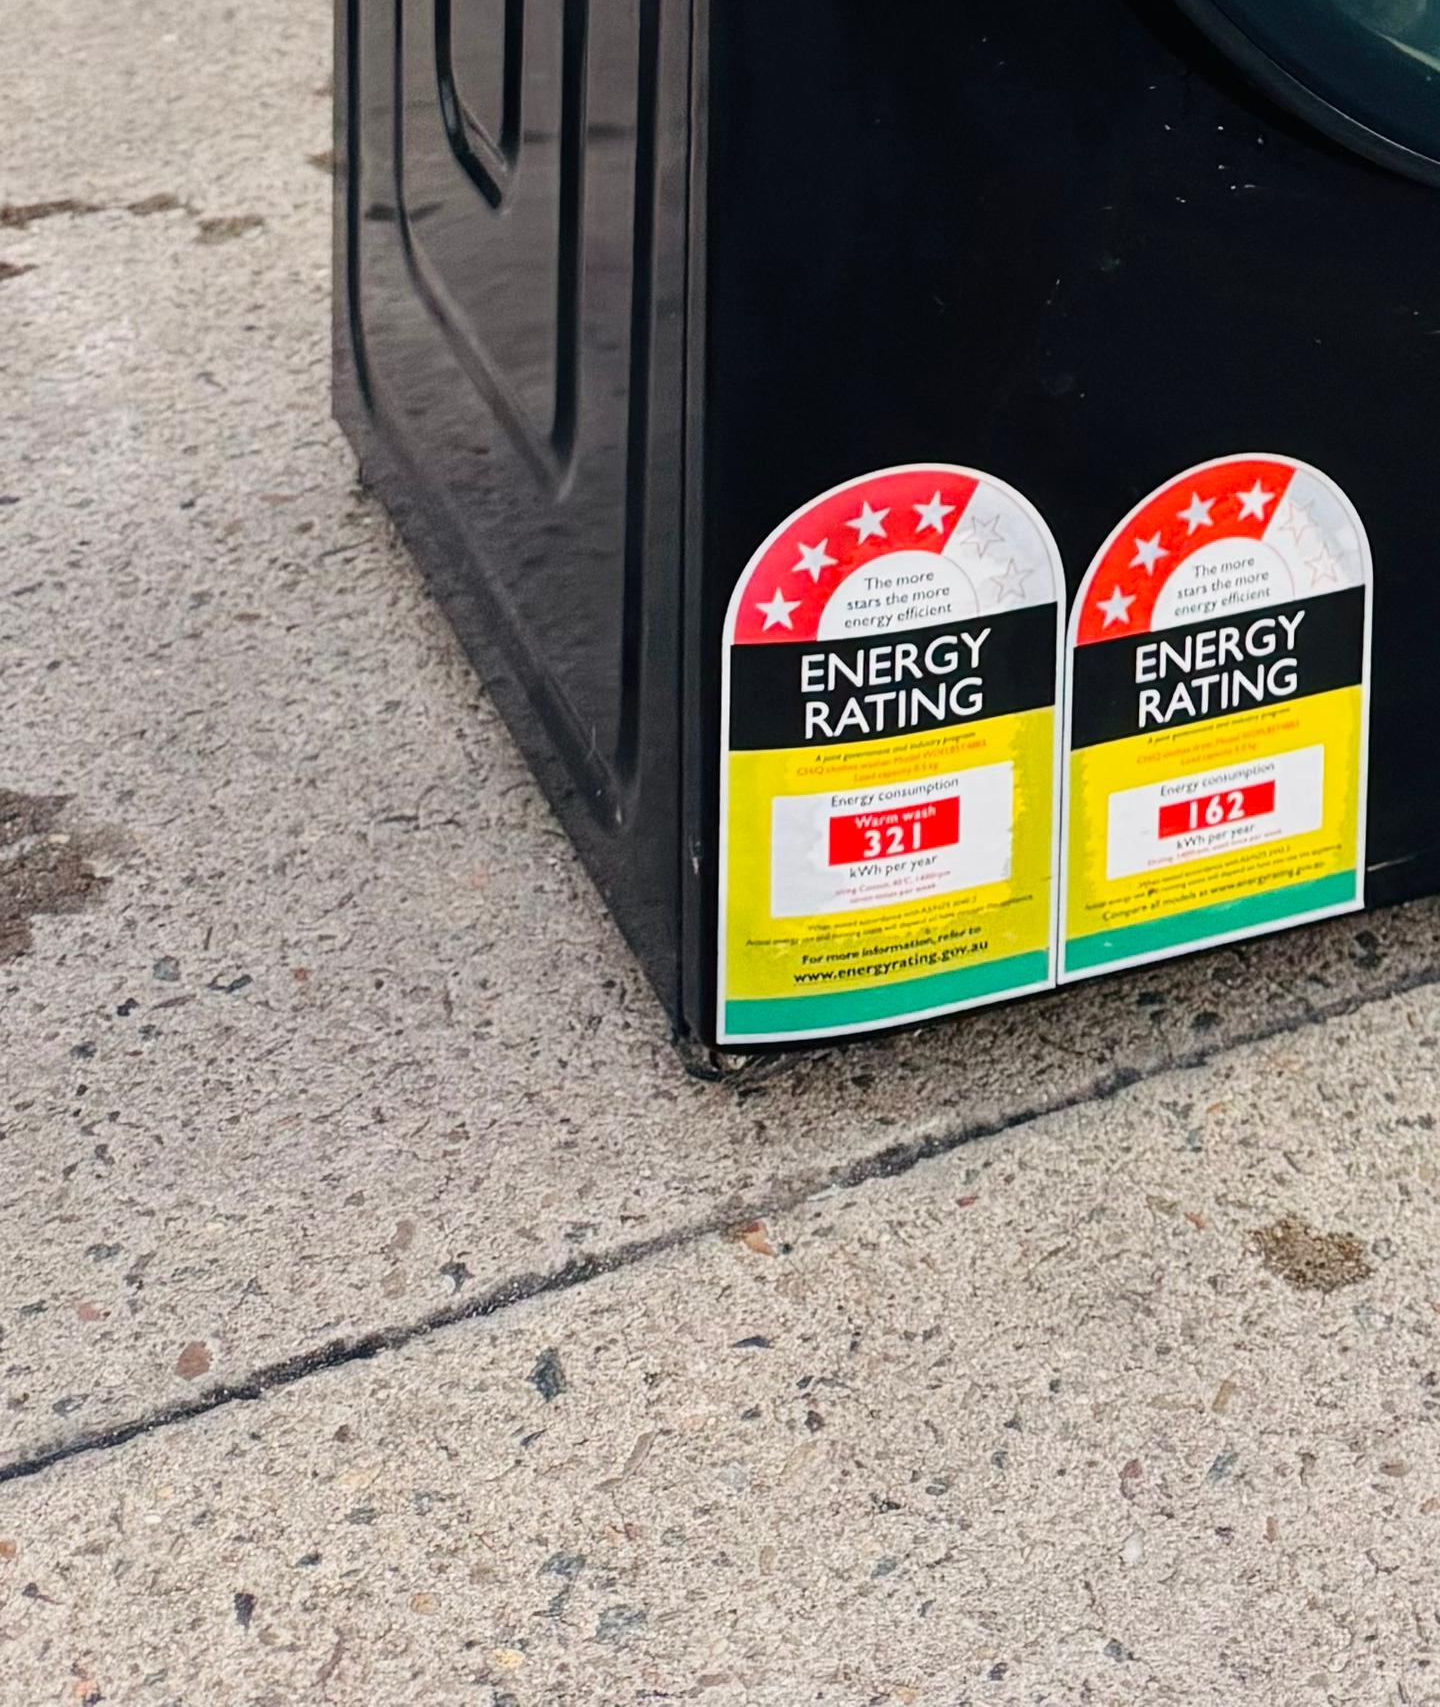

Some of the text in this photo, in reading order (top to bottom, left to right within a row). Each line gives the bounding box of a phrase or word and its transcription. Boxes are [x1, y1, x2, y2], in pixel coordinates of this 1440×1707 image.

[865, 571, 935, 592] The more
[1193, 557, 1255, 579] The more
[847, 585, 951, 611] stars the more
[1177, 570, 1269, 600] stars the more
[844, 602, 953, 630] energy efficient
[1174, 587, 1271, 618] energy efficient
[801, 627, 992, 693] ENERGY
[1135, 609, 1306, 685] ENERGY
[804, 676, 984, 740] RATING
[1138, 657, 1299, 729] RATING
[831, 777, 959, 808] Energy consumption
[1160, 761, 1275, 797] Energy consumption
[855, 805, 937, 829] Warm wash
[1189, 790, 1245, 830] 162
[863, 821, 922, 859] 321
[1177, 833, 1205, 849] kWh
[1208, 830, 1227, 845] per
[1231, 823, 1255, 839] year
[850, 855, 938, 879] kWh per year
[802, 925, 982, 966] For more information, refer to
[794, 940, 989, 985] www.energyrating.gov.au
